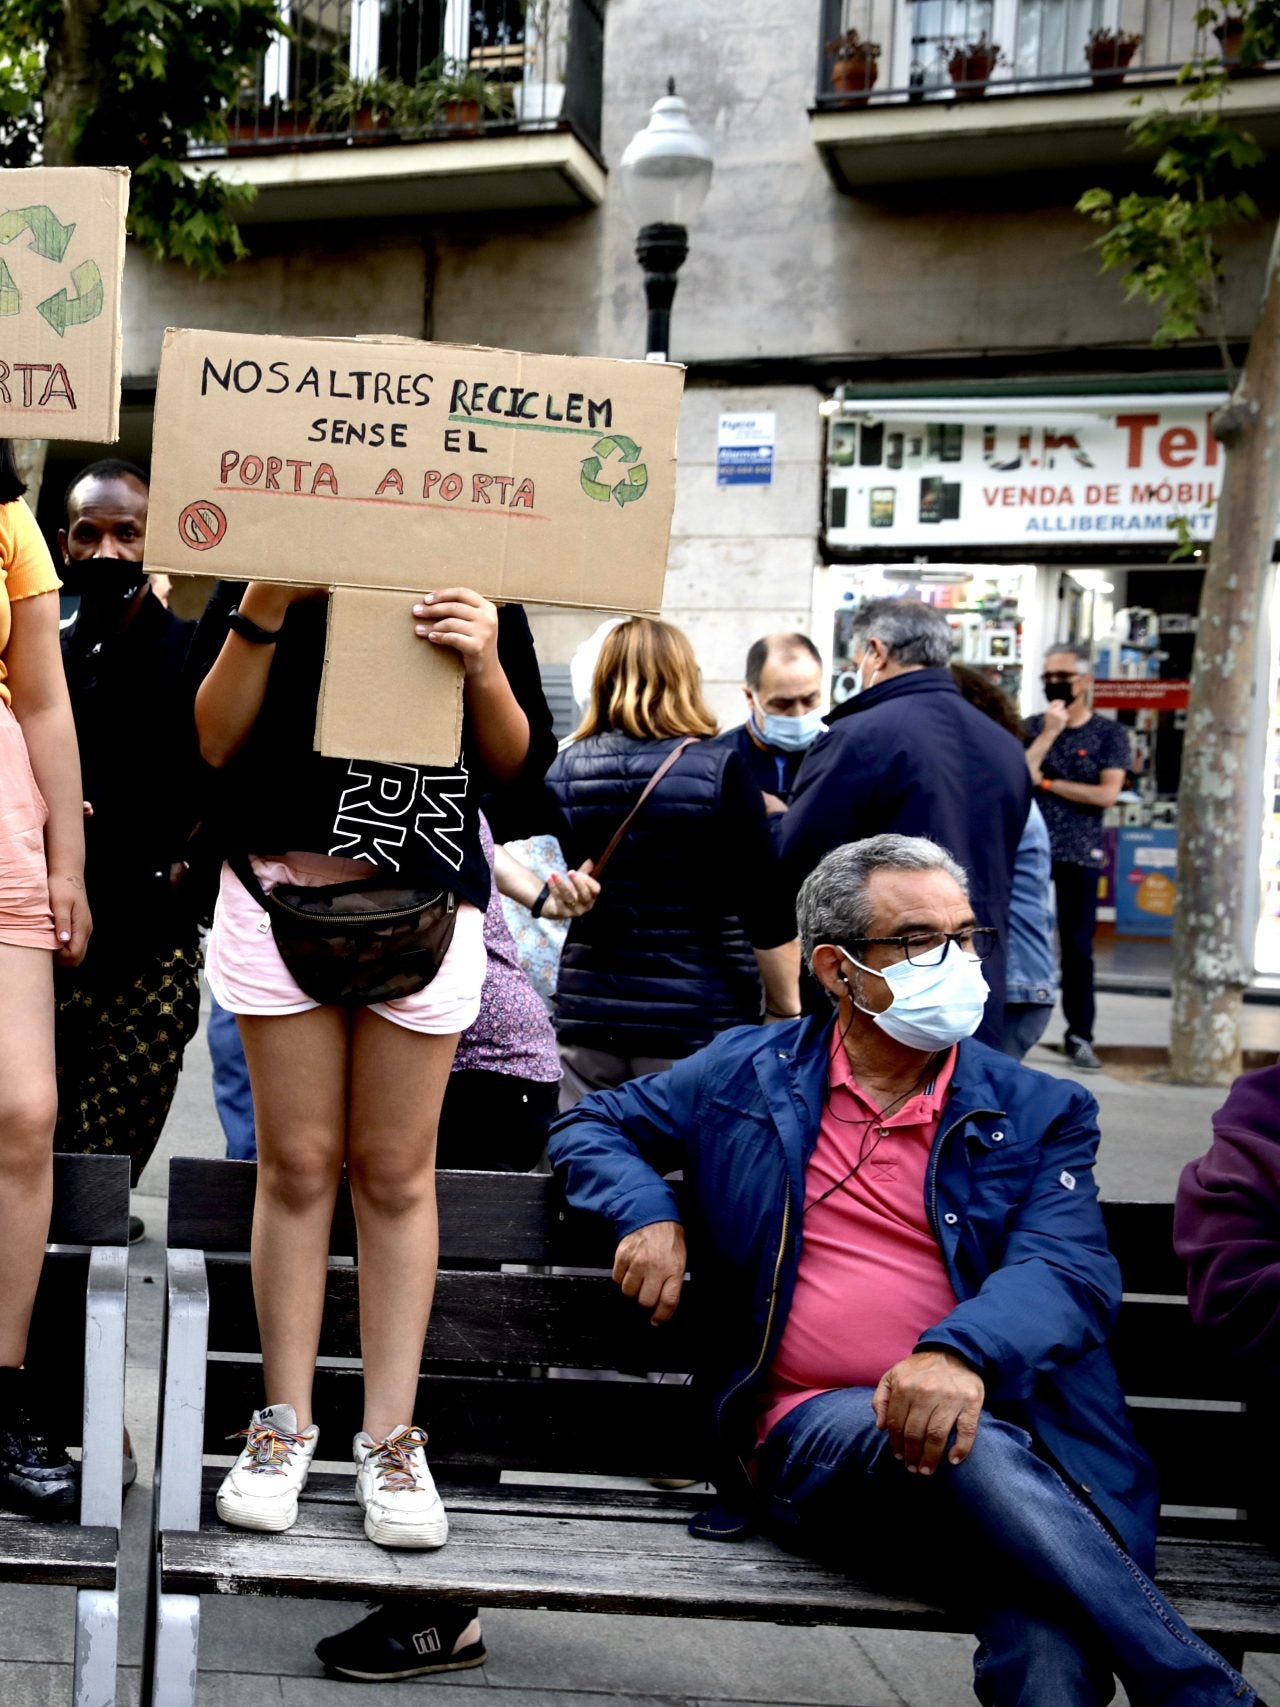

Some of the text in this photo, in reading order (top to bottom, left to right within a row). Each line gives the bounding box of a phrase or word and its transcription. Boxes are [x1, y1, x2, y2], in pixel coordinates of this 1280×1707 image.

[201, 357, 613, 428] NOSALTRES RECICLEM
[308, 418, 488, 454] SENSE EL
[220, 450, 535, 509] PORTA A PORTA
[982, 485, 1074, 507] VENDA
[1085, 484, 1120, 505] DE
